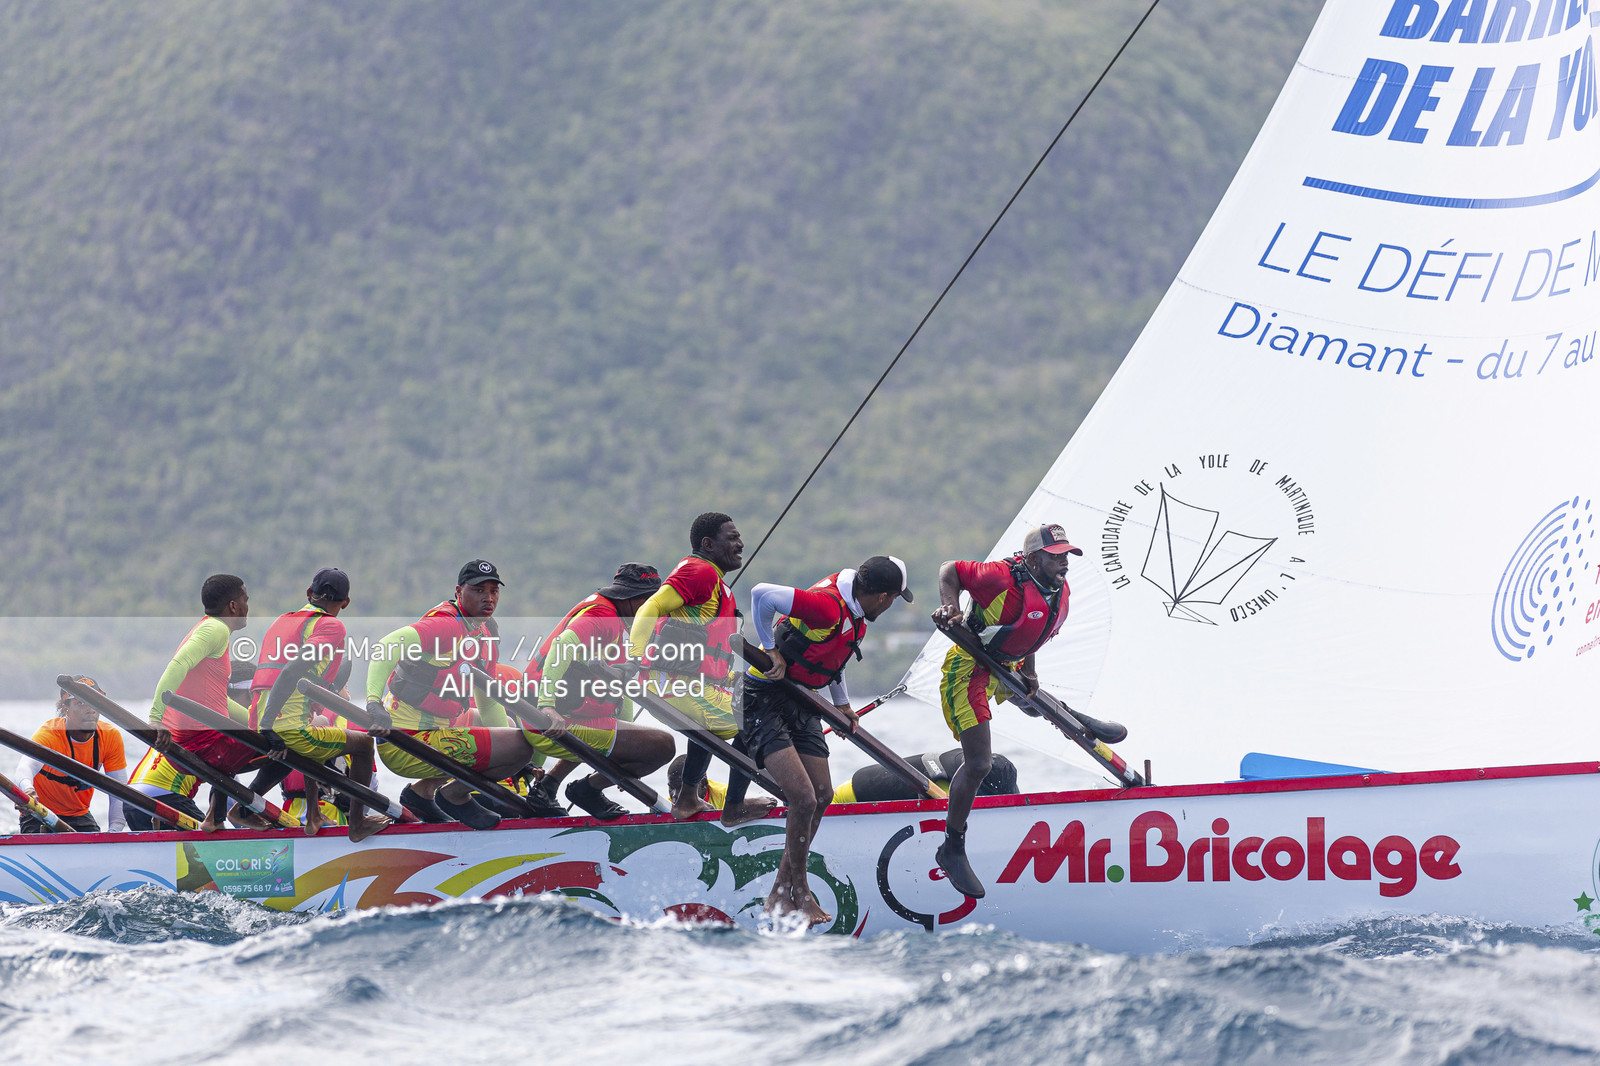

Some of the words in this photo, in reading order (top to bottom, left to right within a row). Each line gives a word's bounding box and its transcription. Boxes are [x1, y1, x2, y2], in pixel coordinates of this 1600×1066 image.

[1331, 57, 1455, 144] DE
[1445, 63, 1541, 147] LA
[1258, 222, 1352, 283] LE
[1357, 238, 1504, 303] DÉFI
[1511, 238, 1582, 302] DE
[1217, 301, 1433, 378] Diamant
[1476, 338, 1529, 380] du
[1536, 332, 1563, 376] 7
[1563, 330, 1597, 369] au
[1199, 454, 1230, 469] YOLE
[1249, 459, 1269, 476] DE
[1164, 463, 1182, 479] LA
[1133, 479, 1154, 496] DE
[1275, 474, 1315, 536] MARTINIQUE
[1101, 499, 1133, 573] CANDIDATURE
[1112, 574, 1131, 590] LA
[215, 856, 272, 871] COLORI'S
[243, 884, 253, 893] 75
